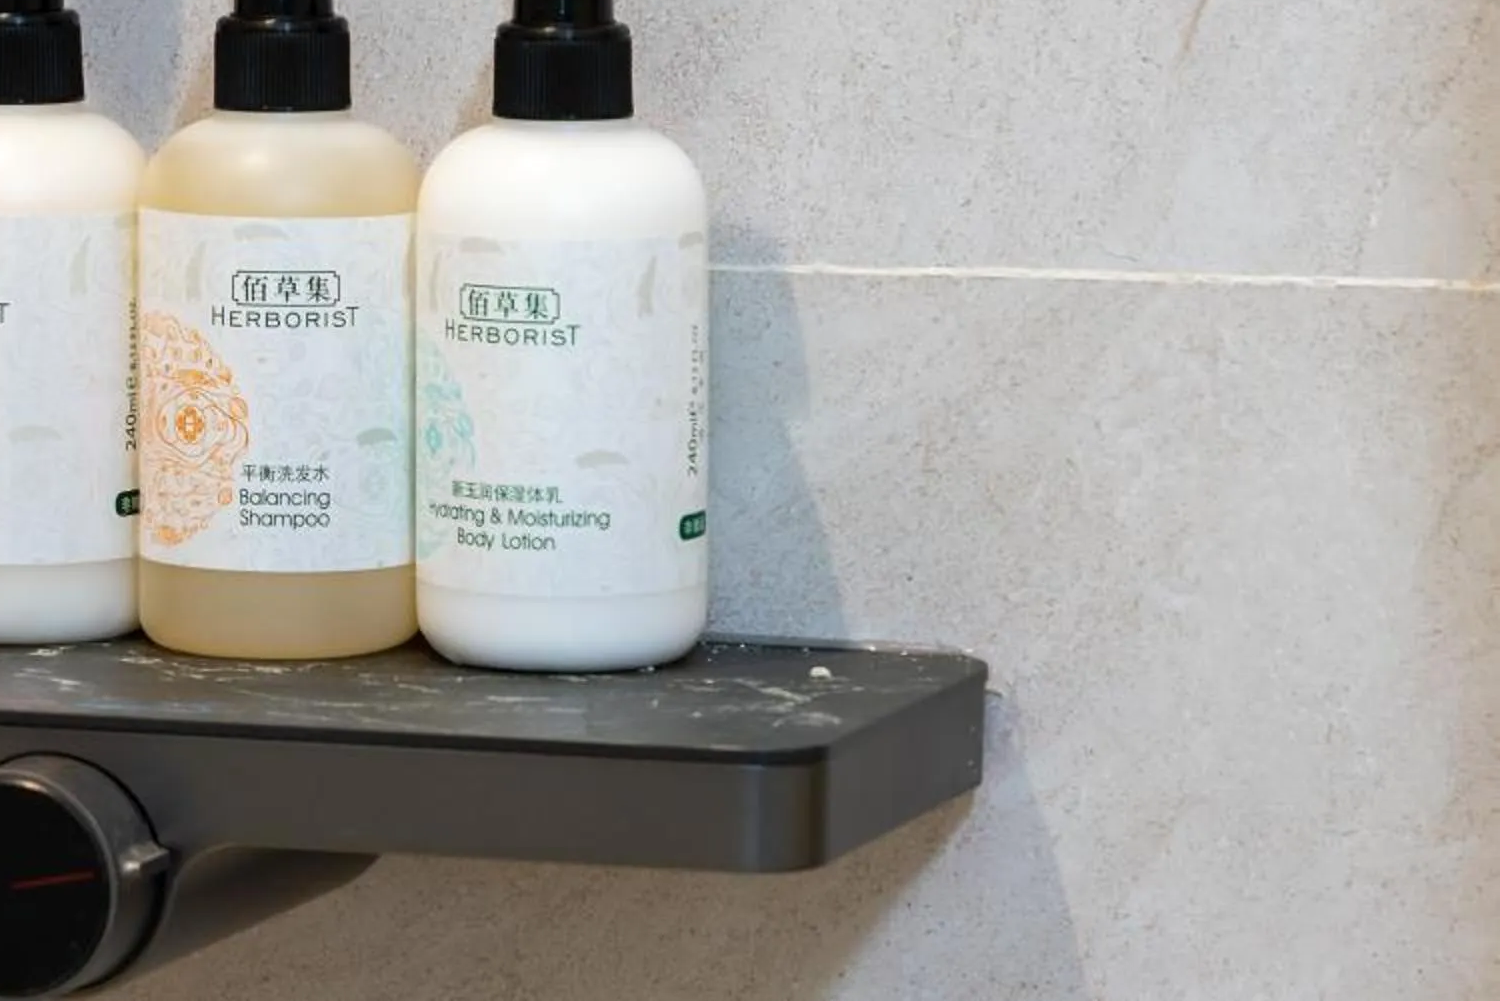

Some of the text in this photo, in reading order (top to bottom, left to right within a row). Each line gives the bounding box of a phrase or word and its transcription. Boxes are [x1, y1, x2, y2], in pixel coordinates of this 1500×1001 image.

[242, 275, 331, 303] 佰草集
[466, 288, 549, 319] 佰草集
[210, 305, 360, 329] HERBORIST
[445, 318, 581, 347] HERBORIST
[239, 487, 331, 510] Balancing
[239, 507, 331, 530] Shampoo
[489, 506, 502, 524] &
[507, 507, 612, 531] Moisturizing
[457, 526, 557, 551] Body Lotion
